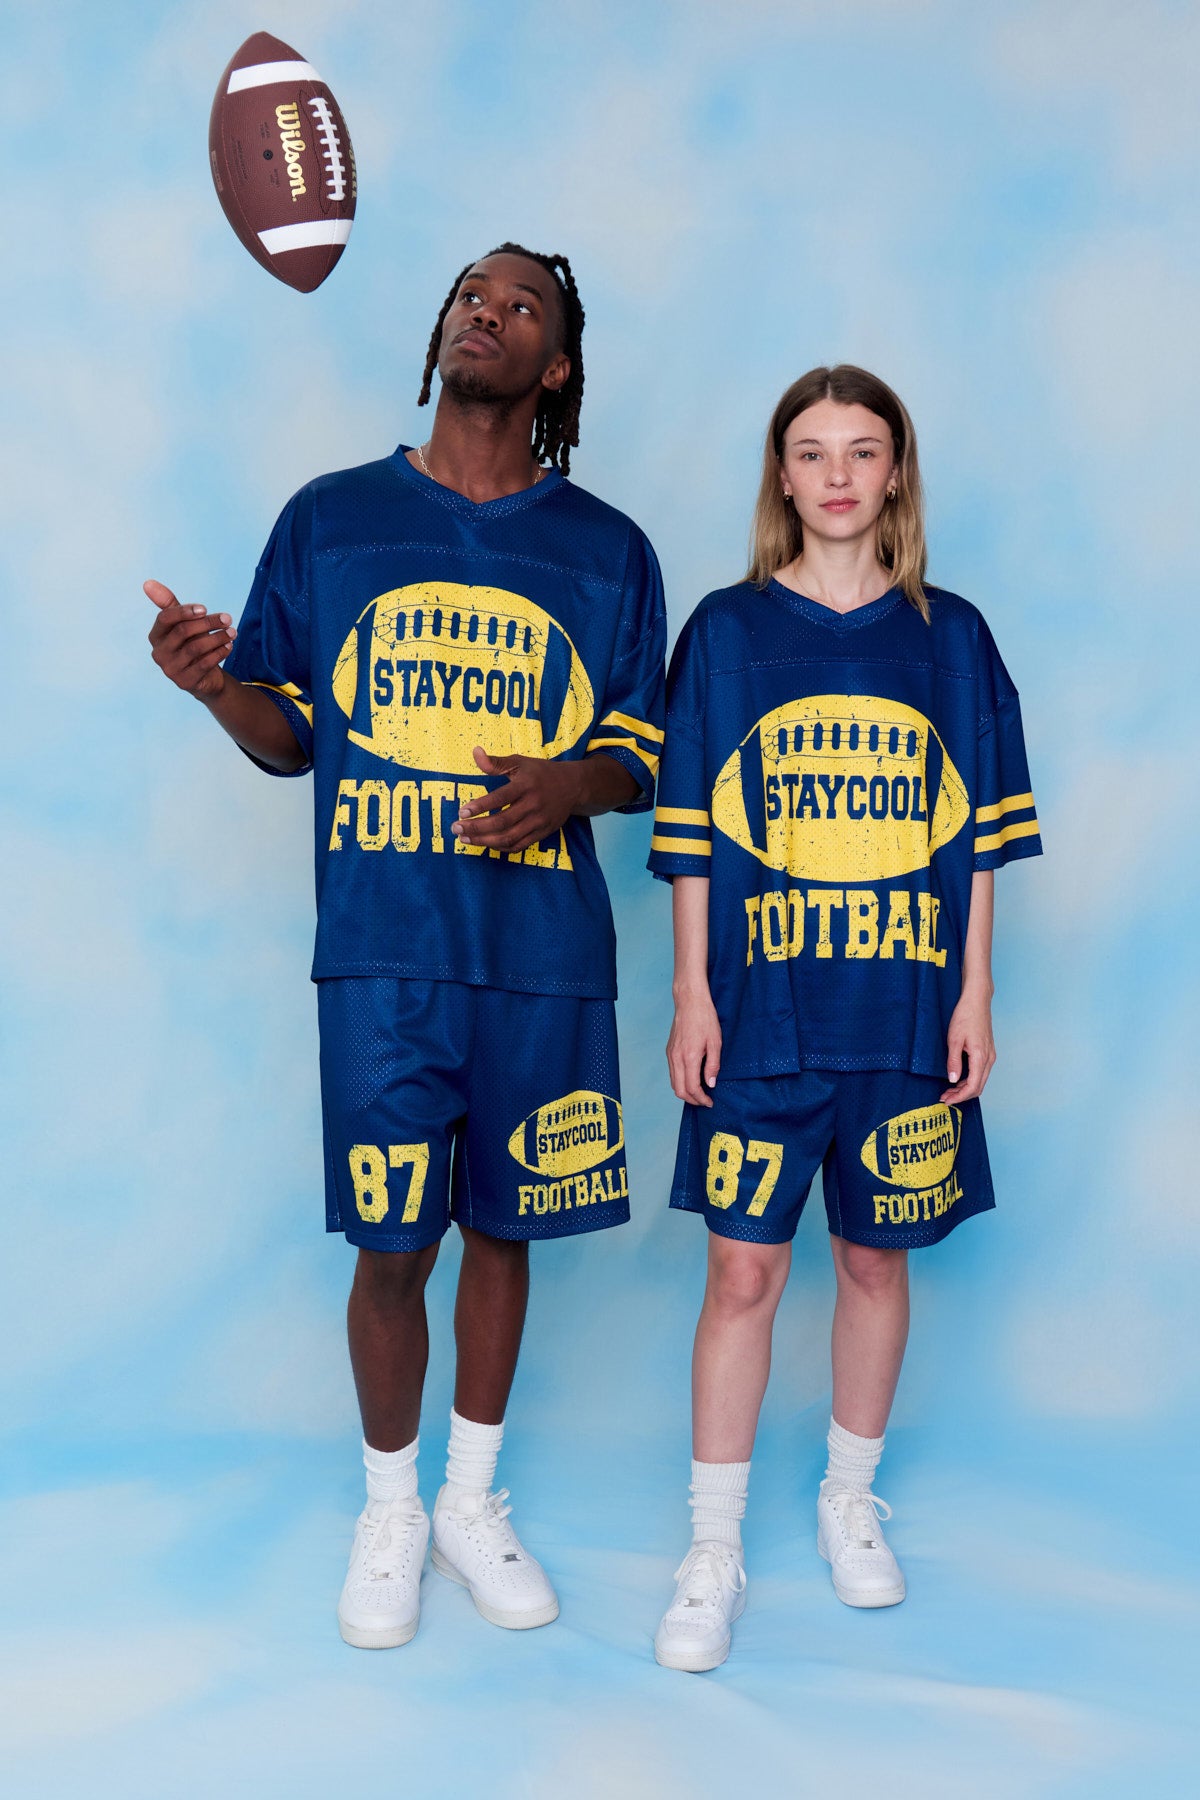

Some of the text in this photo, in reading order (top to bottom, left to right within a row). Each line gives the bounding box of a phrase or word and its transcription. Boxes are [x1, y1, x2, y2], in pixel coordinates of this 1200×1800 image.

[275, 102, 306, 201] Wilson
[373, 656, 541, 721] STAYCOOL
[328, 779, 574, 871] FOOT
[766, 774, 927, 822] STAYCOOL
[538, 1121, 606, 1154] STAYCOOL
[890, 1131, 954, 1165] STAYCOOL
[348, 1142, 430, 1223] 87
[518, 1166, 629, 1216] FOOTBALL
[705, 1131, 784, 1217] 87
